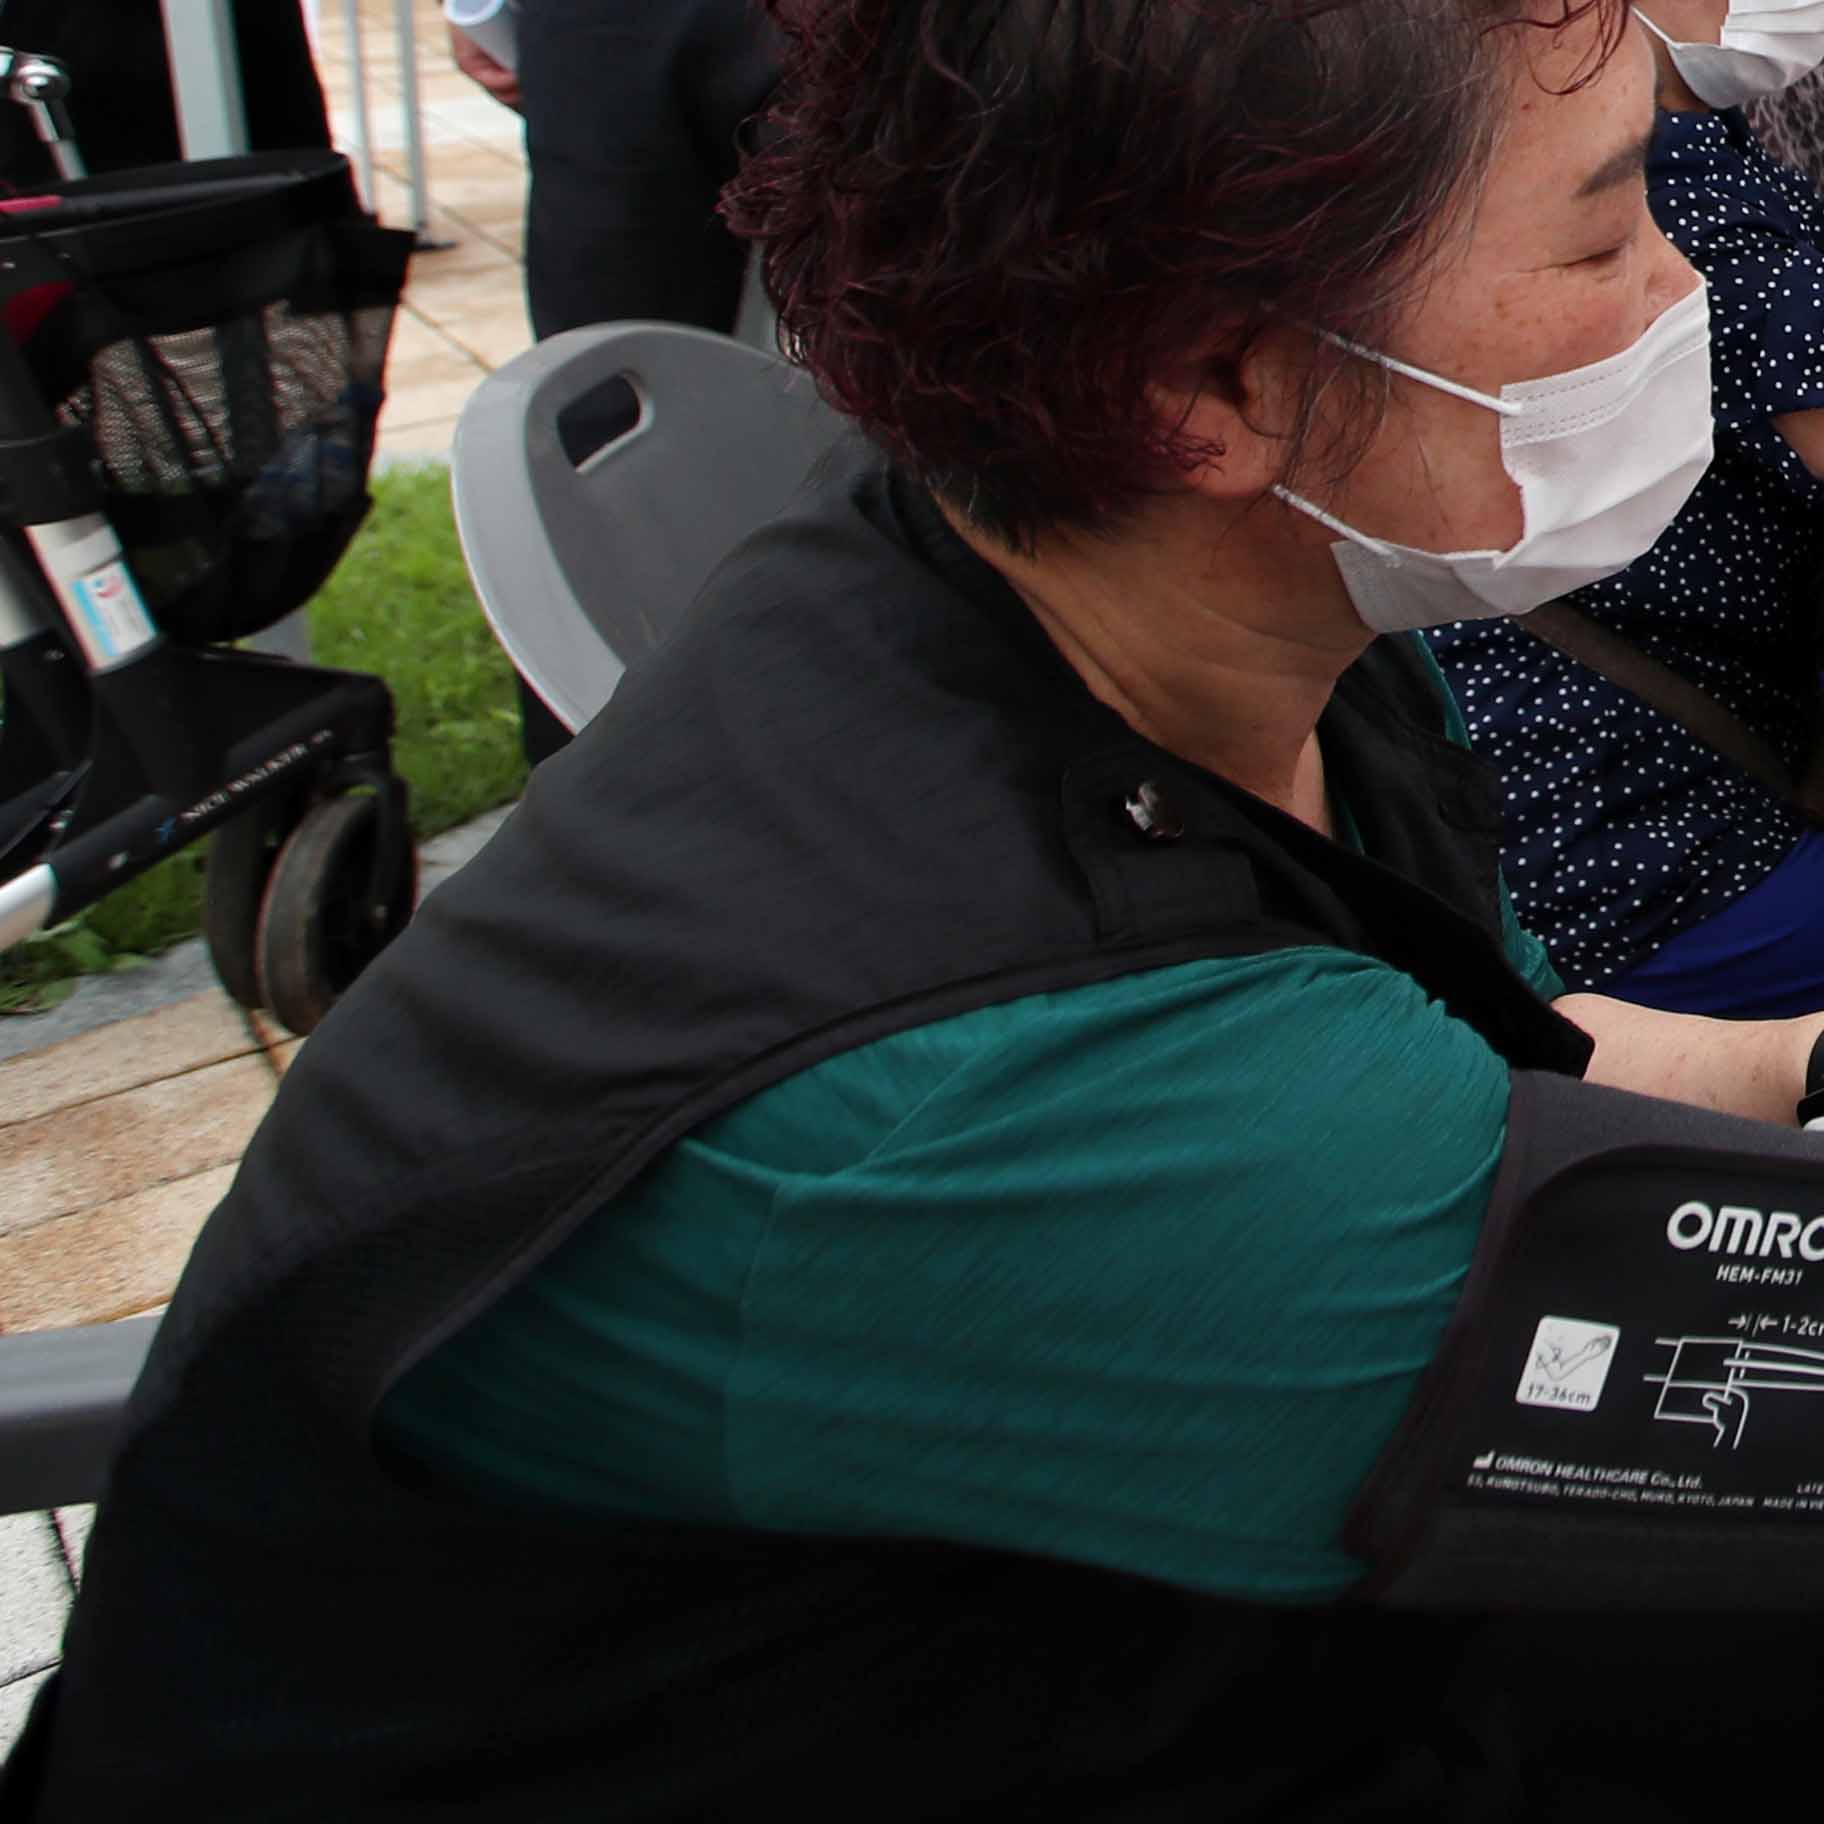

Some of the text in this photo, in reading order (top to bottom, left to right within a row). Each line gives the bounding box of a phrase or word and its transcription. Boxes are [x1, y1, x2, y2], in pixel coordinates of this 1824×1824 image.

[1715, 1264, 1804, 1286] HEM-FM31
[1494, 1456, 1552, 1478] OMRON
[1554, 1463, 1648, 1486] HEALTHCARE
